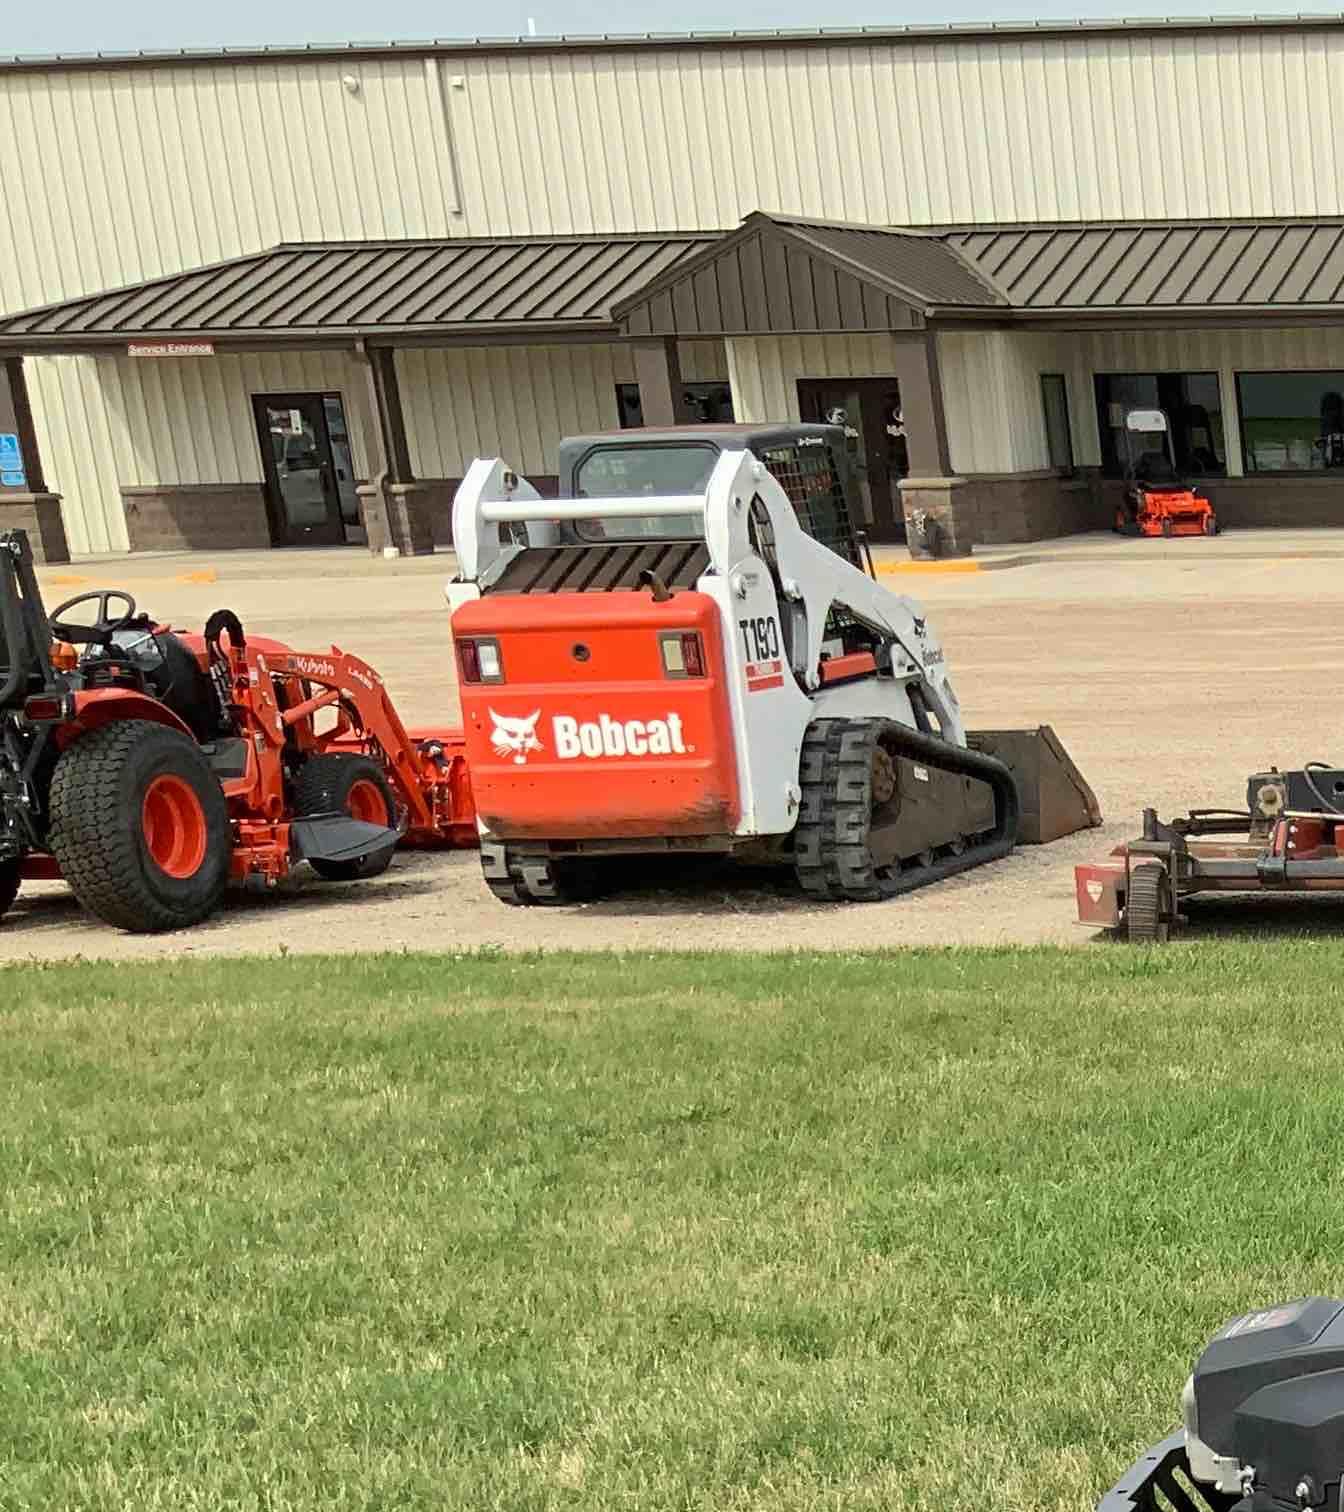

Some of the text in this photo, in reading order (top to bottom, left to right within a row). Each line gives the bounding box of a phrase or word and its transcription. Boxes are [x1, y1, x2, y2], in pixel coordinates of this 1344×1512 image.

[738, 616, 780, 662] T190
[296, 656, 336, 677] Kubota
[552, 711, 687, 759] Bobcat
